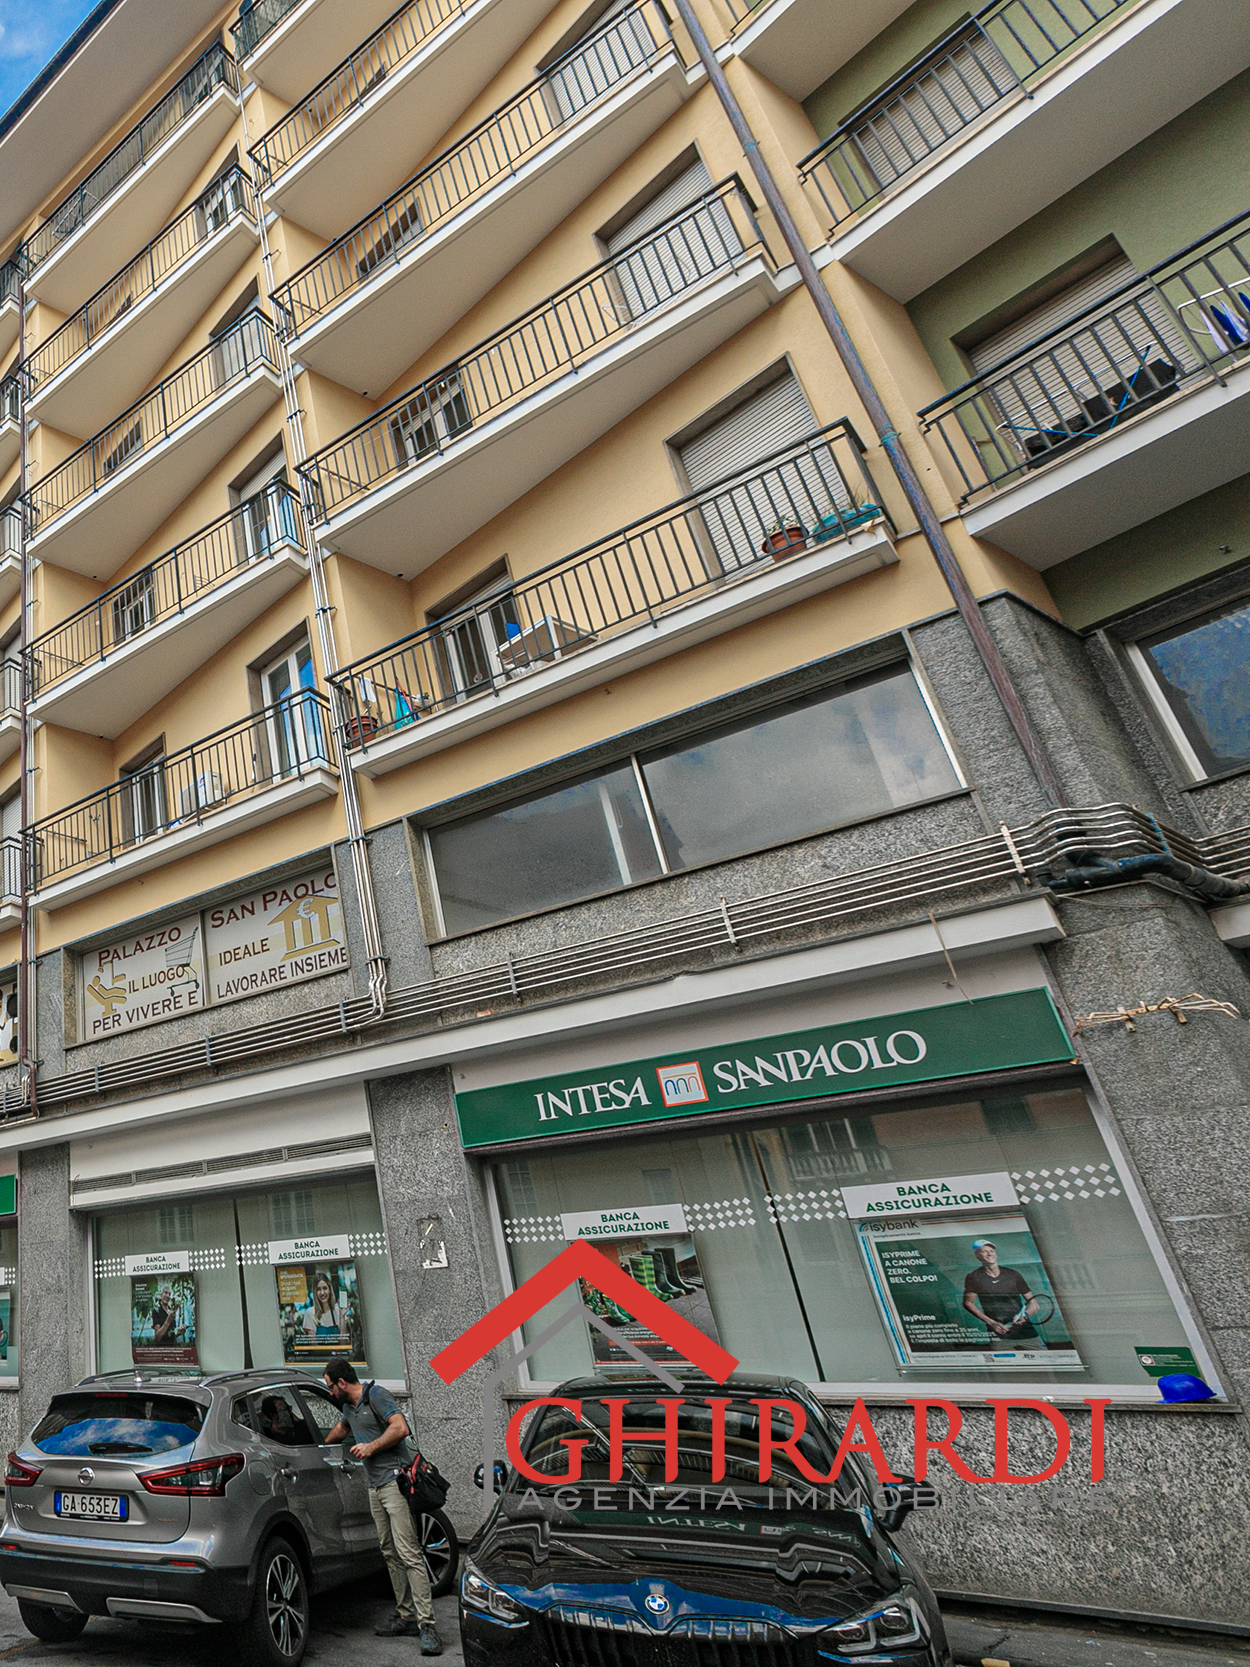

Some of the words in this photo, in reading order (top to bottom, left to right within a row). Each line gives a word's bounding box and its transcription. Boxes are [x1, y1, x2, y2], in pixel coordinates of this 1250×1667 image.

[97, 926, 182, 967] PALAZZO
[211, 901, 255, 929] SAN
[262, 872, 337, 912] PAOLO
[128, 980, 139, 994] IL
[142, 964, 185, 990] LUOGO
[219, 937, 270, 966] IDEALE
[92, 1012, 122, 1034] PER
[125, 995, 184, 1024] VIVERE
[188, 990, 198, 1005] E
[217, 964, 287, 999] LAVORARE
[290, 947, 348, 978] INSIEME
[534, 1076, 652, 1121] INTESA
[712, 1030, 928, 1095] SANPAOLO
[896, 1183, 951, 1197] BANCA
[866, 1192, 994, 1212] ASSICURAZIONE
[601, 1211, 640, 1223] BANCA
[578, 1221, 670, 1235] ASSICURAZIONE
[870, 1219, 918, 1232] isybank
[294, 1241, 320, 1249] BANCA
[146, 1255, 166, 1263] BANCA
[278, 1248, 339, 1260] ASSICURAZIONE
[882, 1250, 920, 1258] ISYPRIME
[132, 1262, 180, 1272] ASSICURAZIONE
[892, 1258, 927, 1266] CANONE
[887, 1268, 911, 1276] ZERO.
[905, 1275, 938, 1283] COLPO!
[63, 1495, 77, 1512] GA
[80, 1496, 119, 1515] 653EZ
